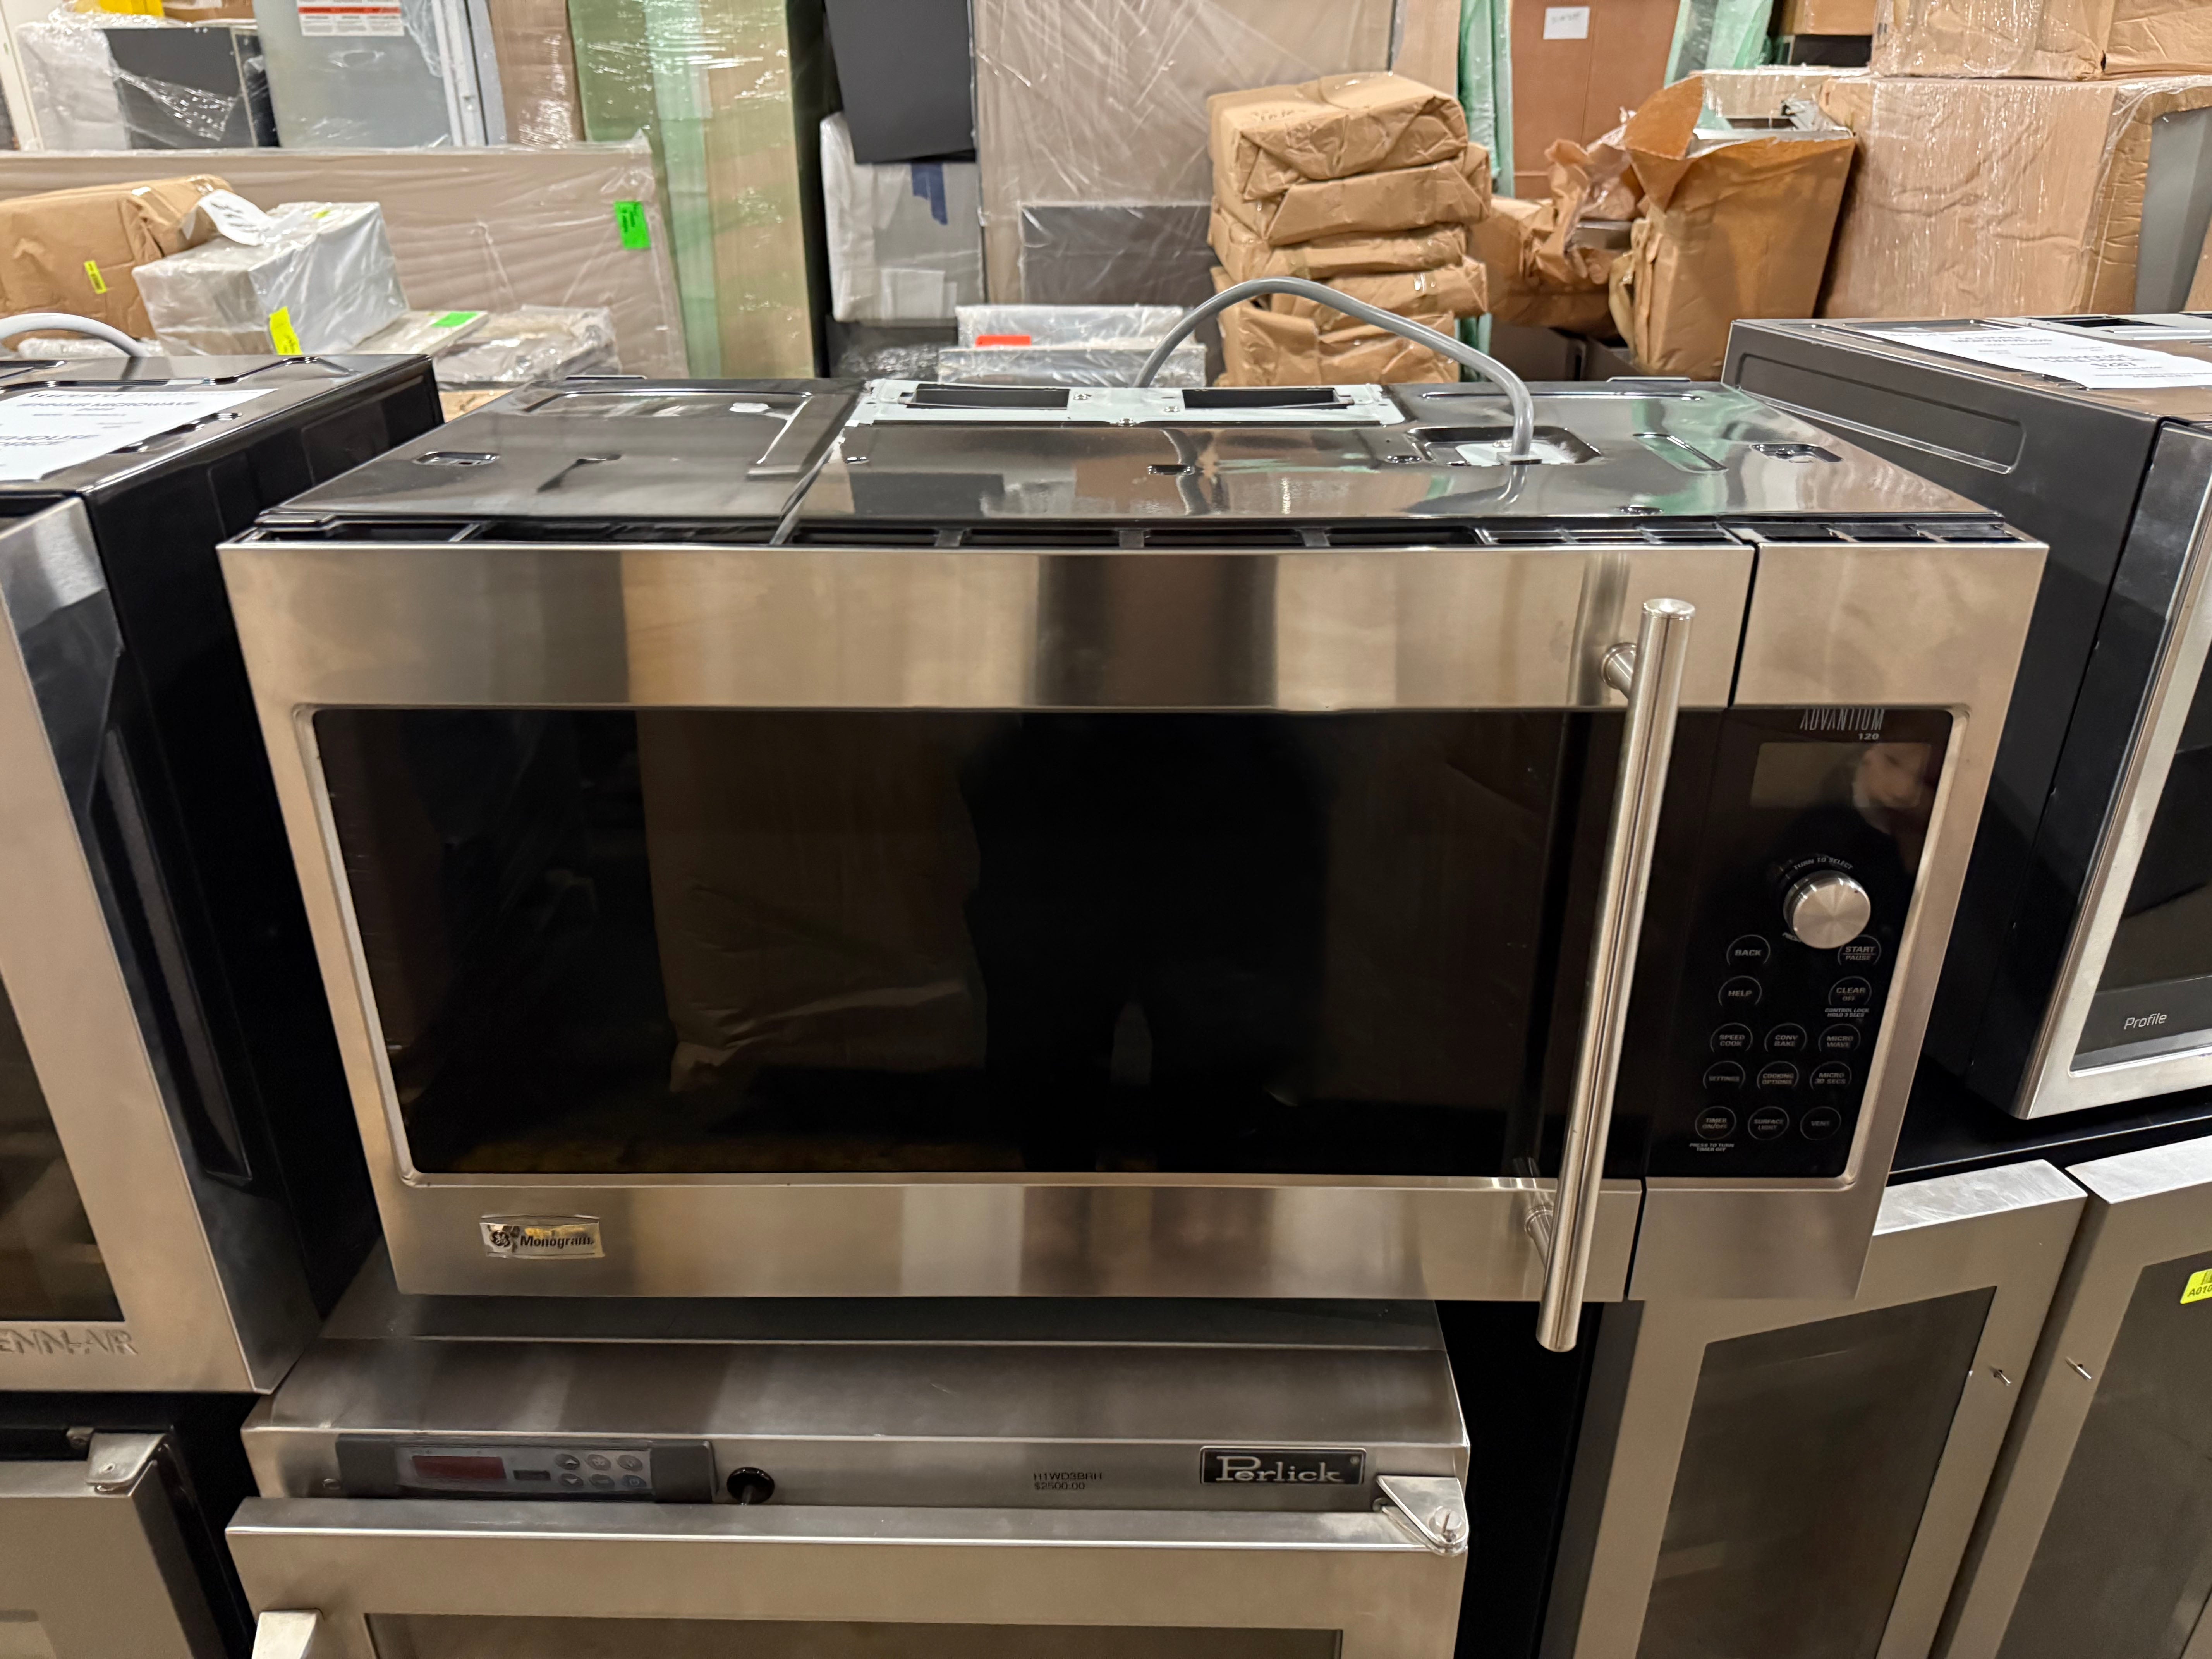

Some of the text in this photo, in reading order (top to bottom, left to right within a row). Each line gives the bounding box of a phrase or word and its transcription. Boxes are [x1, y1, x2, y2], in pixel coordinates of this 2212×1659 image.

[1800, 708, 1885, 730] ADVANTIUM
[1794, 859, 1815, 870] TURN
[1829, 857, 1853, 869] SELECT
[2123, 1013, 2167, 1030] Profile
[520, 1235, 590, 1248] Monogram
[1216, 1455, 1345, 1482] Perlick
